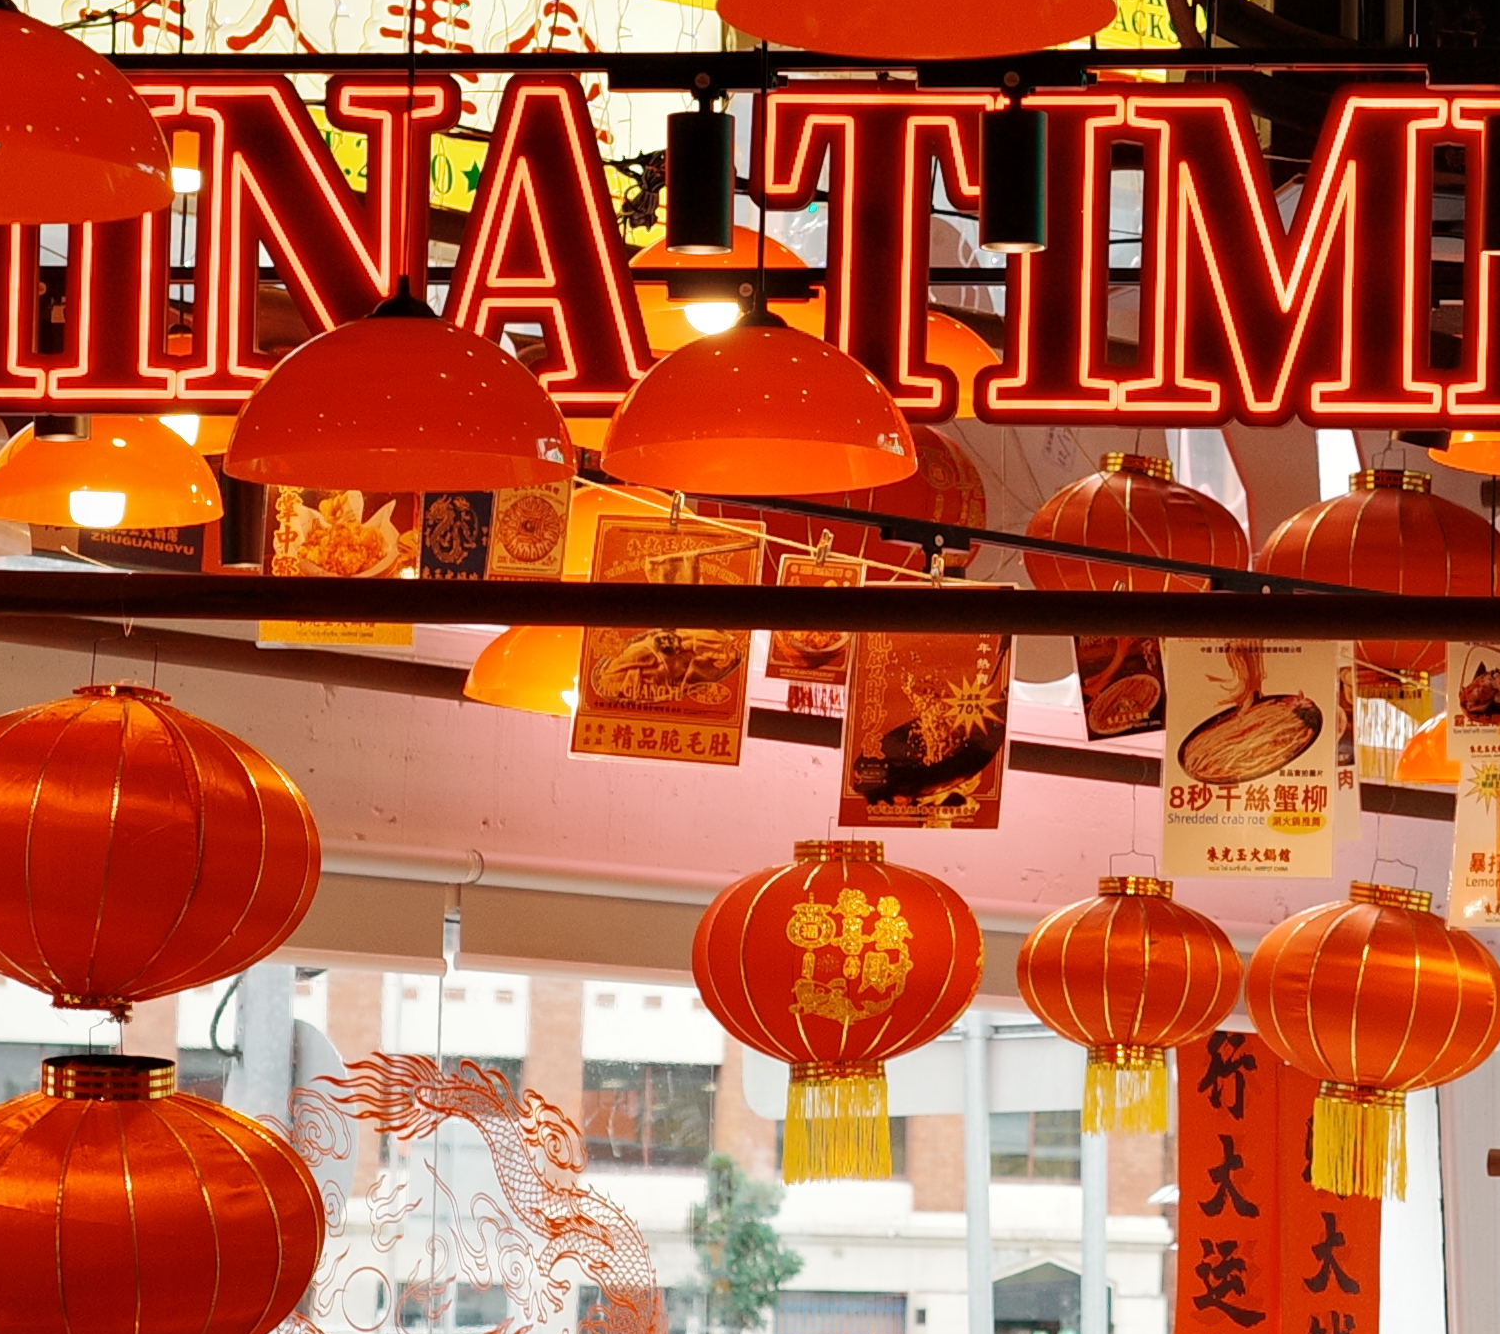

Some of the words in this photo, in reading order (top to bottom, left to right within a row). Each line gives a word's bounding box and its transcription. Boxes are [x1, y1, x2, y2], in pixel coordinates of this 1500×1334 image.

[90, 532, 196, 557] ZHUGUANGYU
[610, 723, 733, 758] 精品脆毛肚
[1168, 783, 1328, 814] 8秒千絲蟹柳
[1167, 812, 1219, 825] Shredded
[1221, 812, 1245, 825] crab
